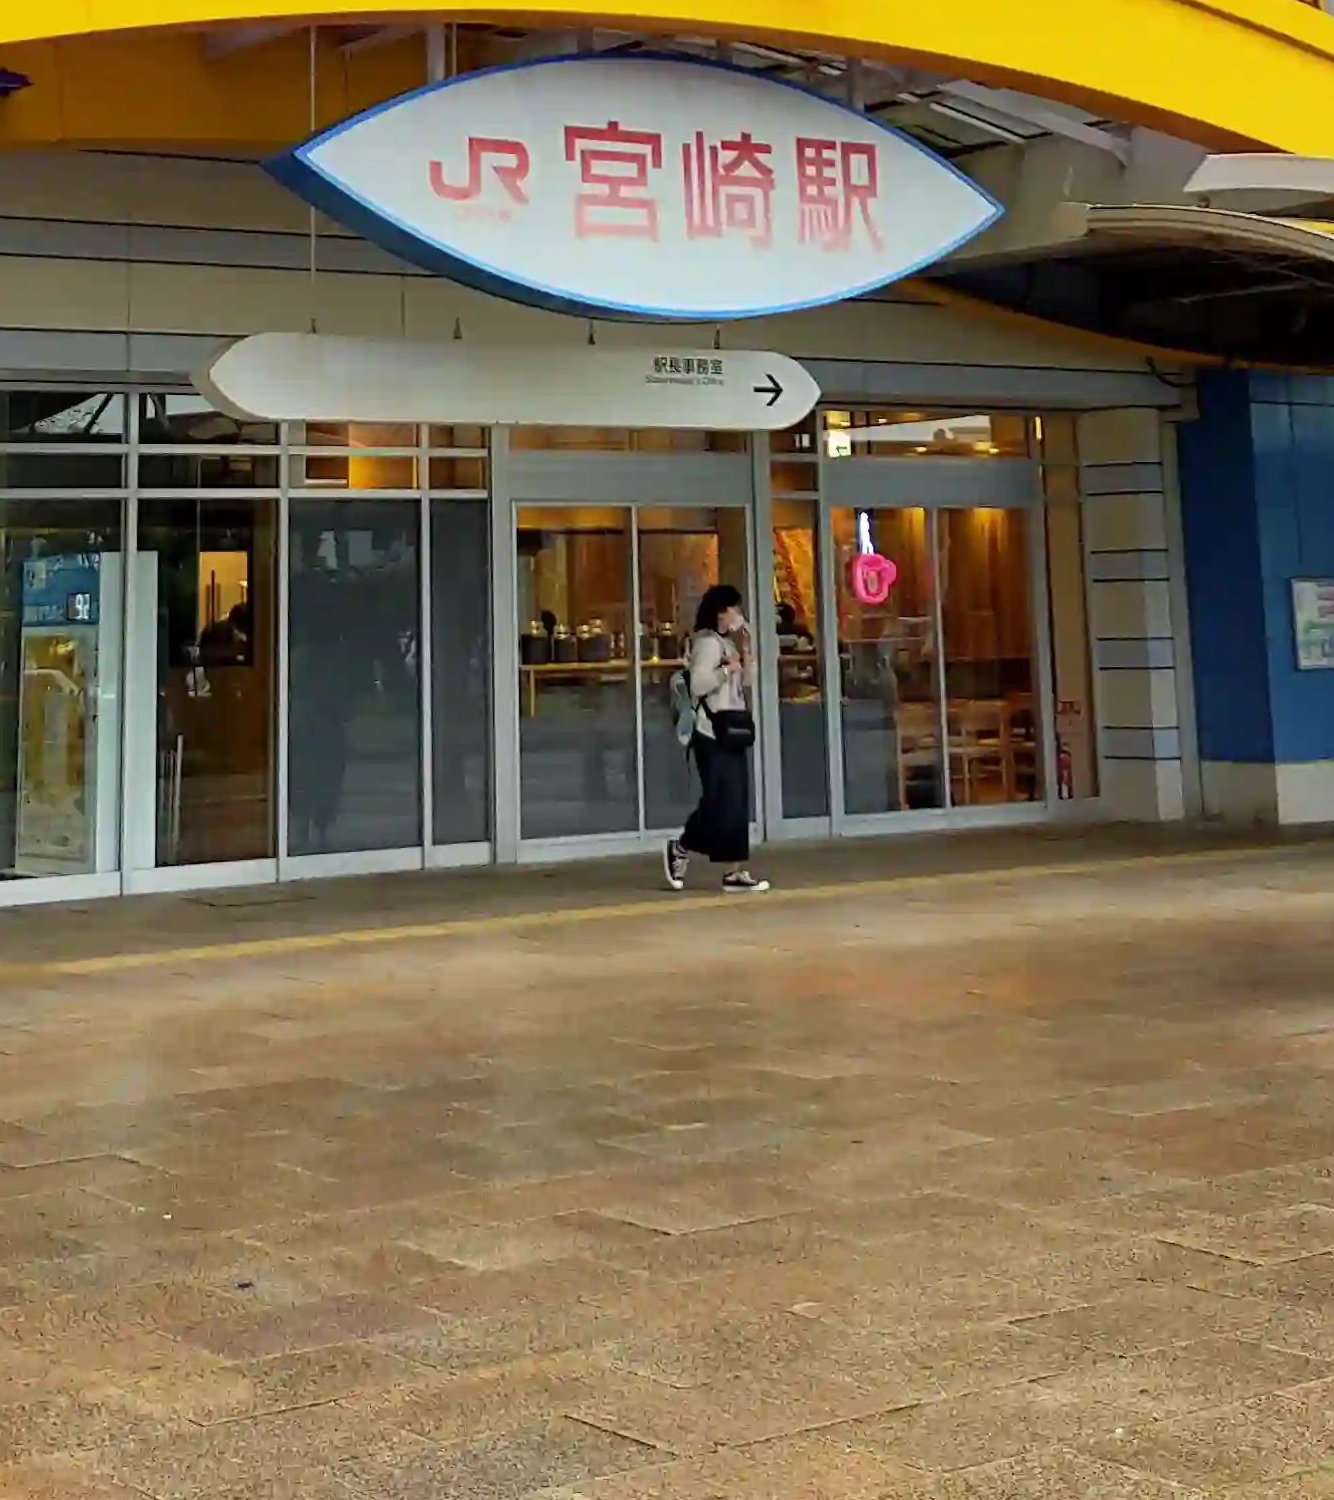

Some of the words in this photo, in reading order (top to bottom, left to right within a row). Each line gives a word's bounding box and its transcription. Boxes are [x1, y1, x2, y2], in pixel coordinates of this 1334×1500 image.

[428, 136, 530, 204] JR
[563, 120, 884, 252] 宮崎駅
